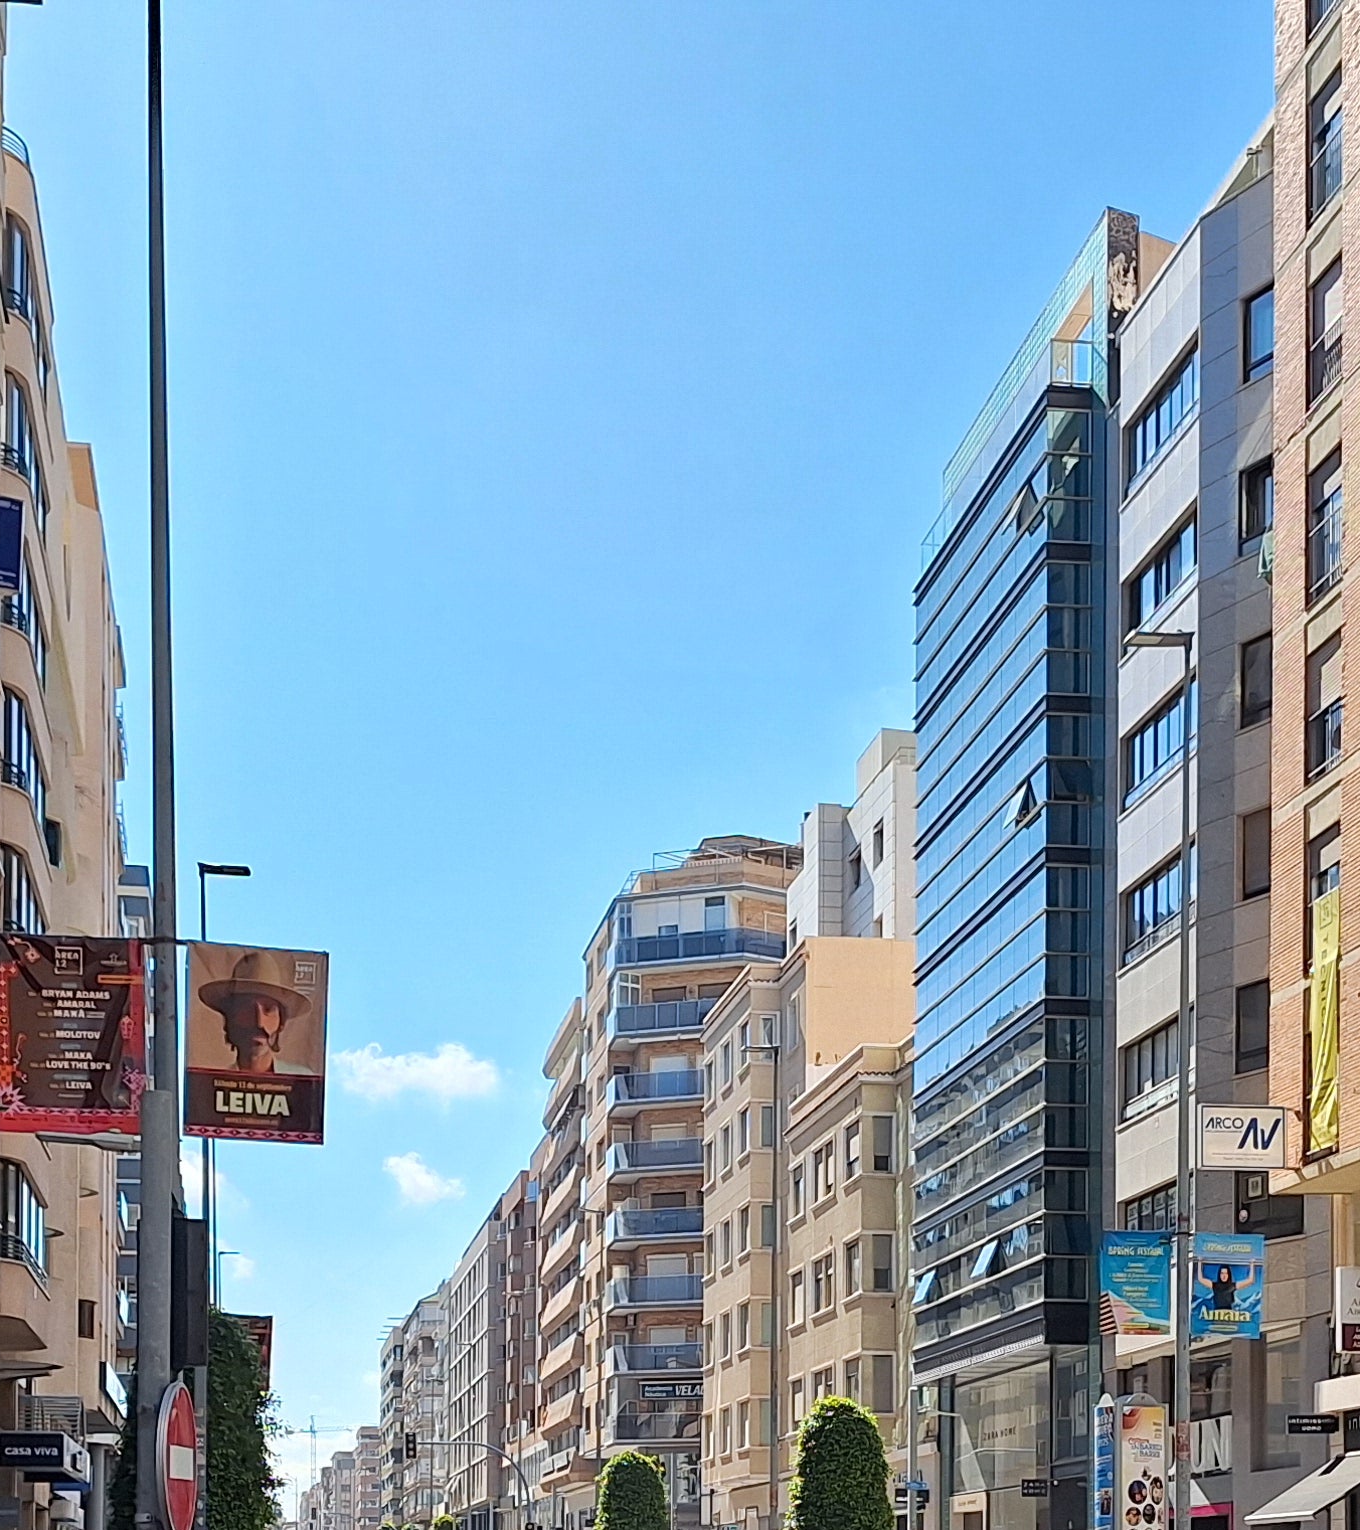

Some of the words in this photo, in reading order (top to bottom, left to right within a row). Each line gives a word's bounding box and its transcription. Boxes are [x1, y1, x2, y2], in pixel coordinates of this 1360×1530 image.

[41, 990, 73, 998] BRYAN
[75, 991, 110, 1000] ADAMS
[56, 1000, 96, 1009] AMARAL
[55, 1030, 101, 1039] MOLOTOV
[45, 1061, 70, 1069] LOVE
[70, 1061, 89, 1069] THE
[65, 1081, 93, 1090] LEIVA
[216, 1090, 290, 1116] LEIVA
[1205, 1117, 1244, 1129] ARCO
[4, 1446, 32, 1456] casa
[34, 1446, 59, 1456] viva
